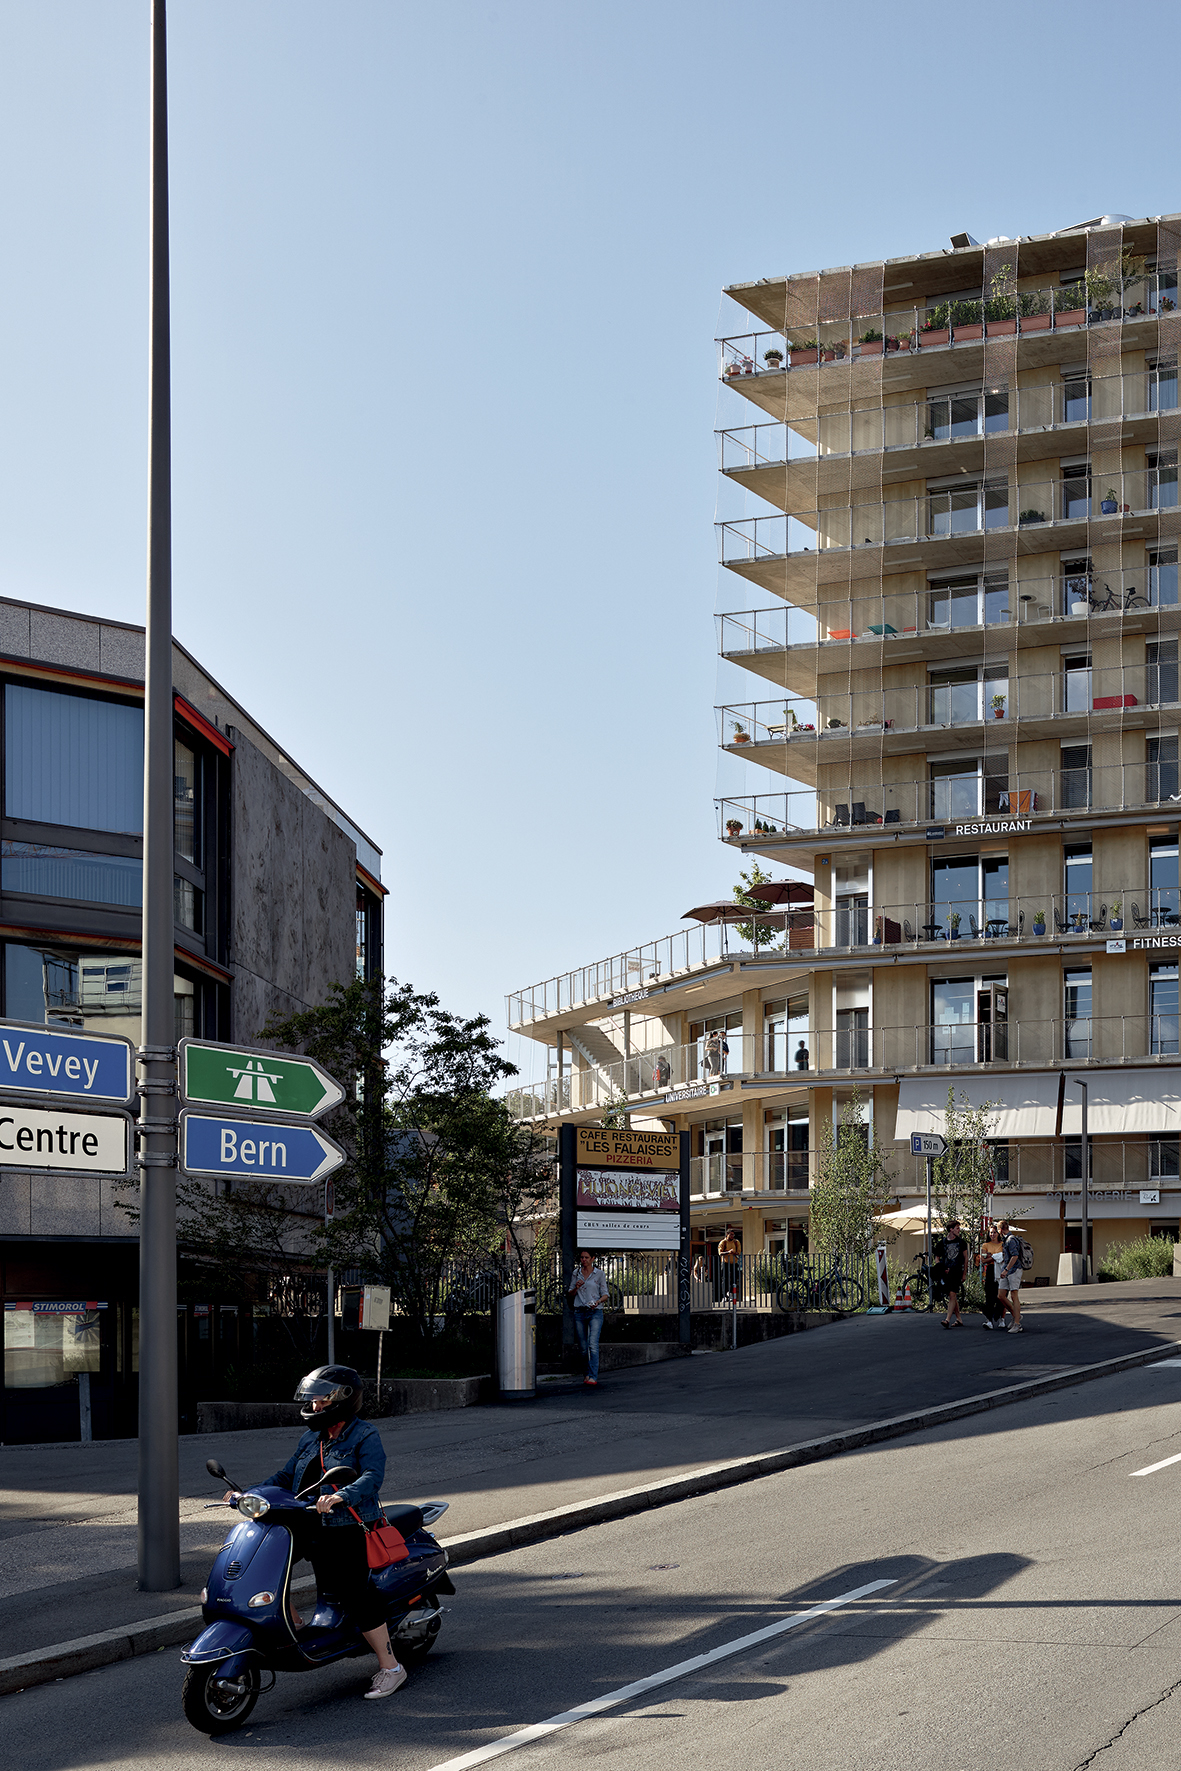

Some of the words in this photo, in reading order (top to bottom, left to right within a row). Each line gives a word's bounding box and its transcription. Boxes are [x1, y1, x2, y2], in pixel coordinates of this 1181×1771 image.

[955, 820, 1033, 835] RESTAURANT
[2, 1039, 100, 1090] Vevey
[665, 1085, 707, 1104] UNIVERSITAIRE
[0, 1117, 99, 1157] Centre
[580, 1130, 607, 1140] CAFE
[612, 1132, 677, 1144] RESTAURANT
[219, 1127, 288, 1168] Bern
[923, 1140, 932, 1150] 150
[606, 1154, 653, 1165] PIZZERIA
[33, 1303, 85, 1311] STIMOROL
